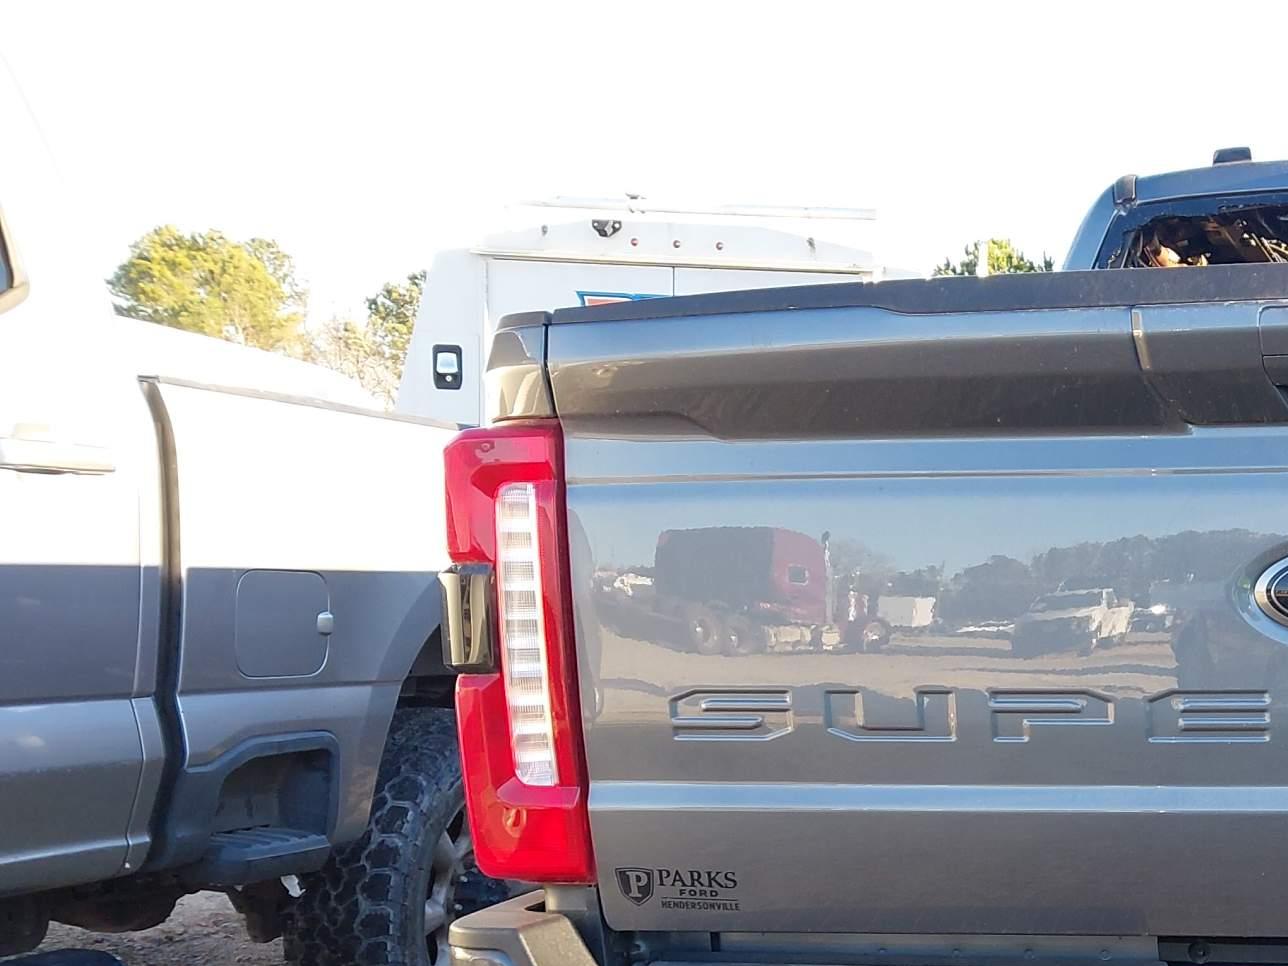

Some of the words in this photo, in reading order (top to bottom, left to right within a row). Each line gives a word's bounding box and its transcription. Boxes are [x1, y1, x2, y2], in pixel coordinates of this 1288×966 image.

[656, 868, 738, 889] PARKS
[679, 888, 719, 898] FORD
[660, 900, 741, 912] HENDERSONVILLE
